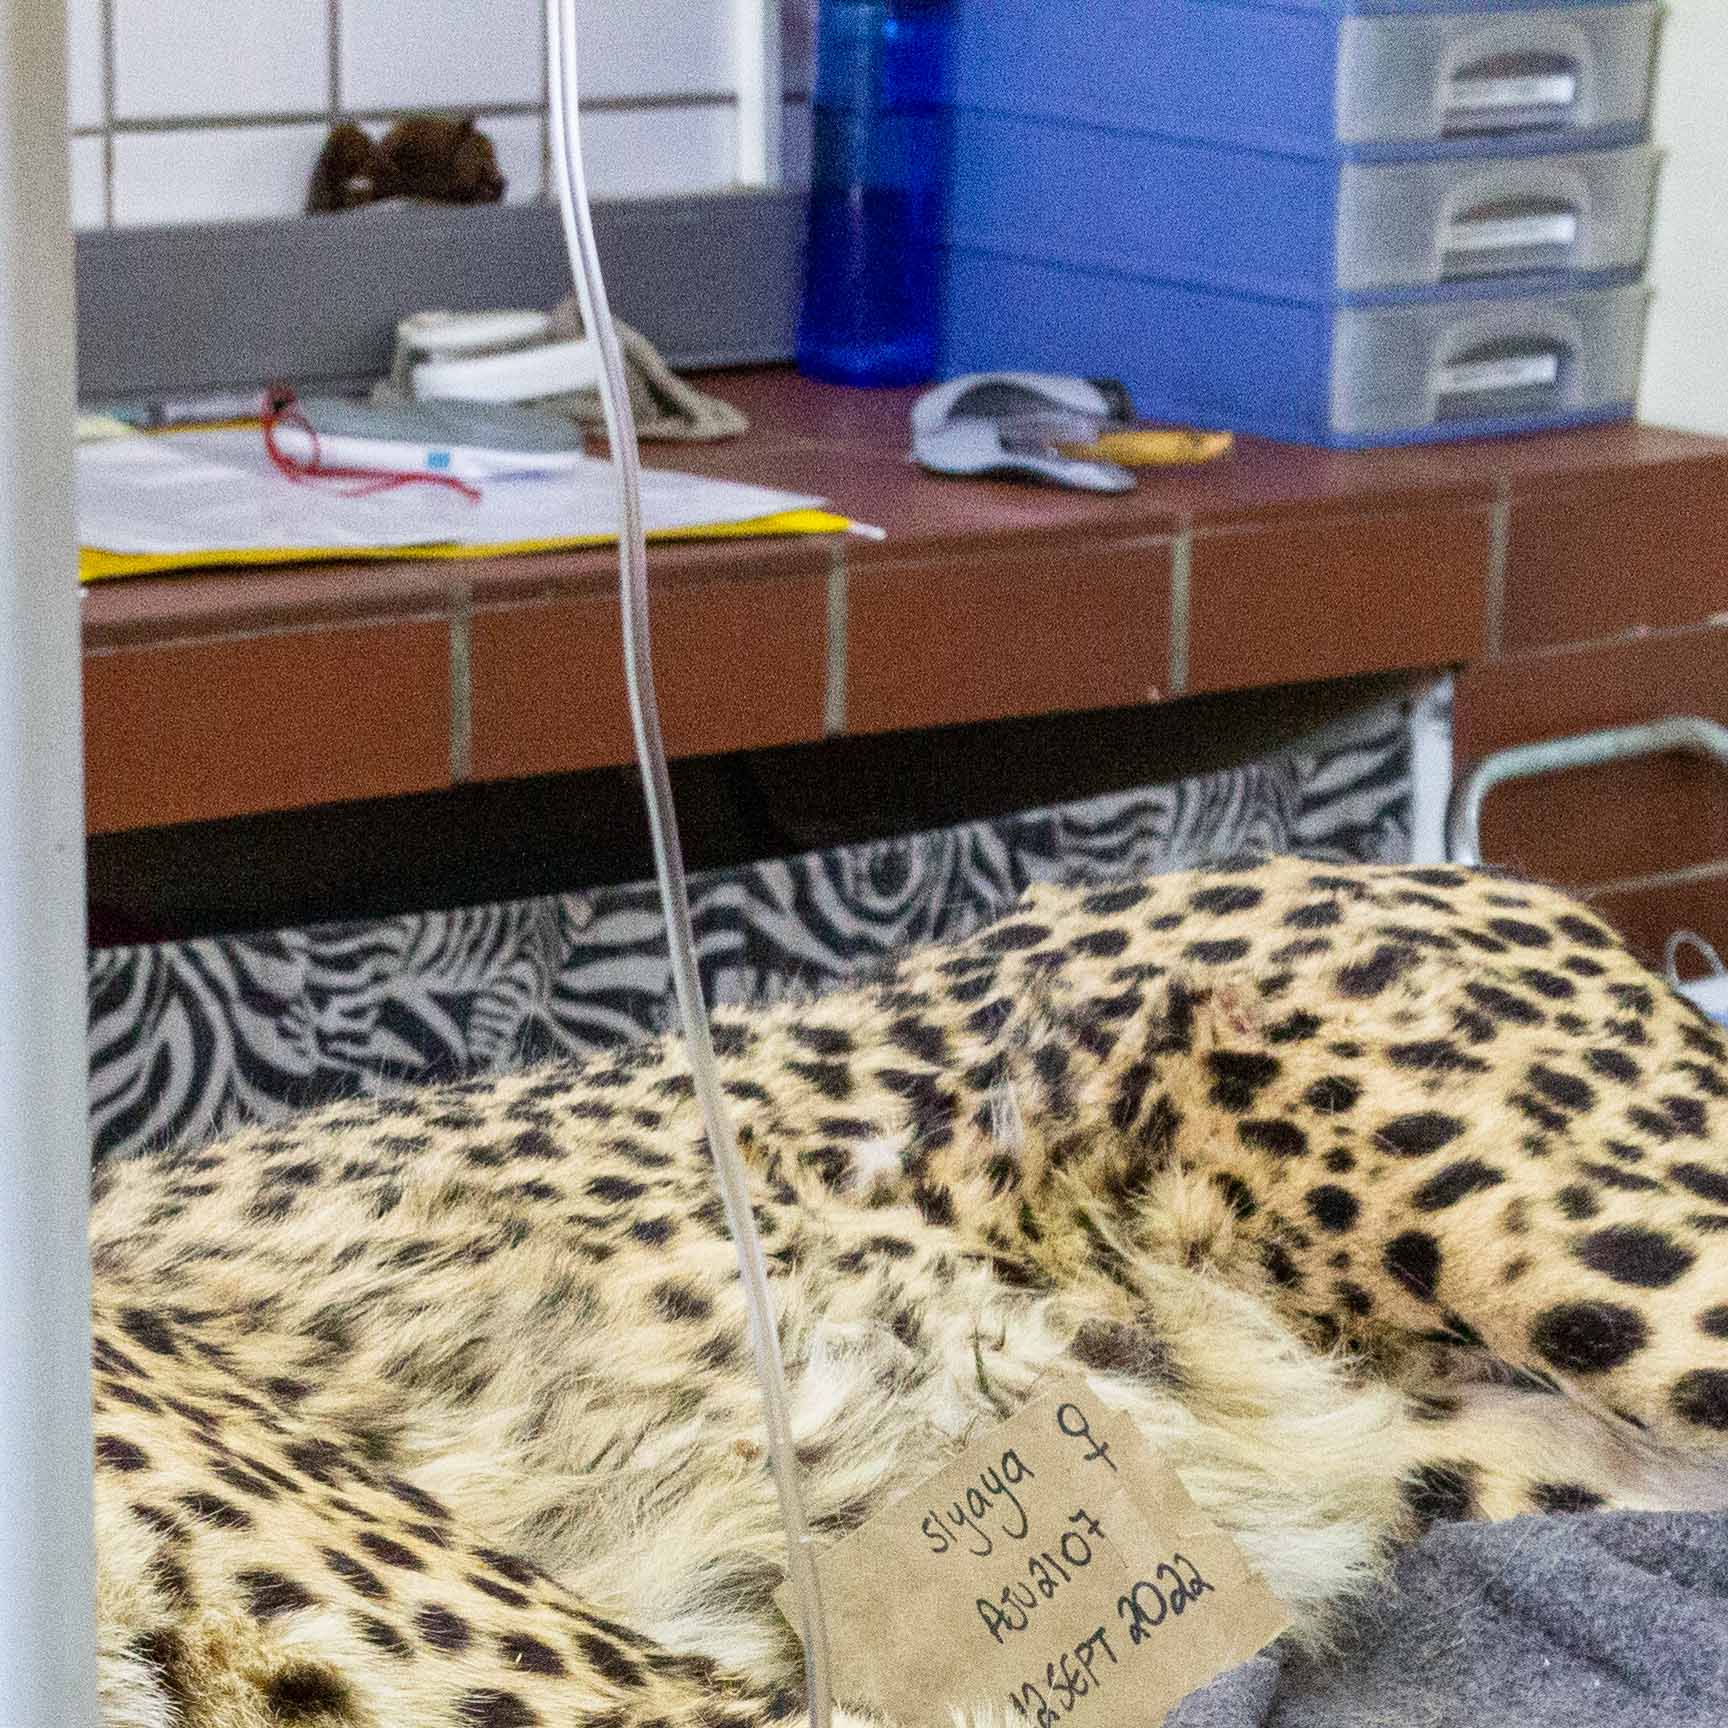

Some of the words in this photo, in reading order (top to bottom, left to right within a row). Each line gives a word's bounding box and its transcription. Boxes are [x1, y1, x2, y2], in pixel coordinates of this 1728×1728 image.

[976, 1509, 1104, 1643] AJU2107
[1047, 1626, 1118, 1712] SEPT
[1118, 1553, 1215, 1644] 2022
